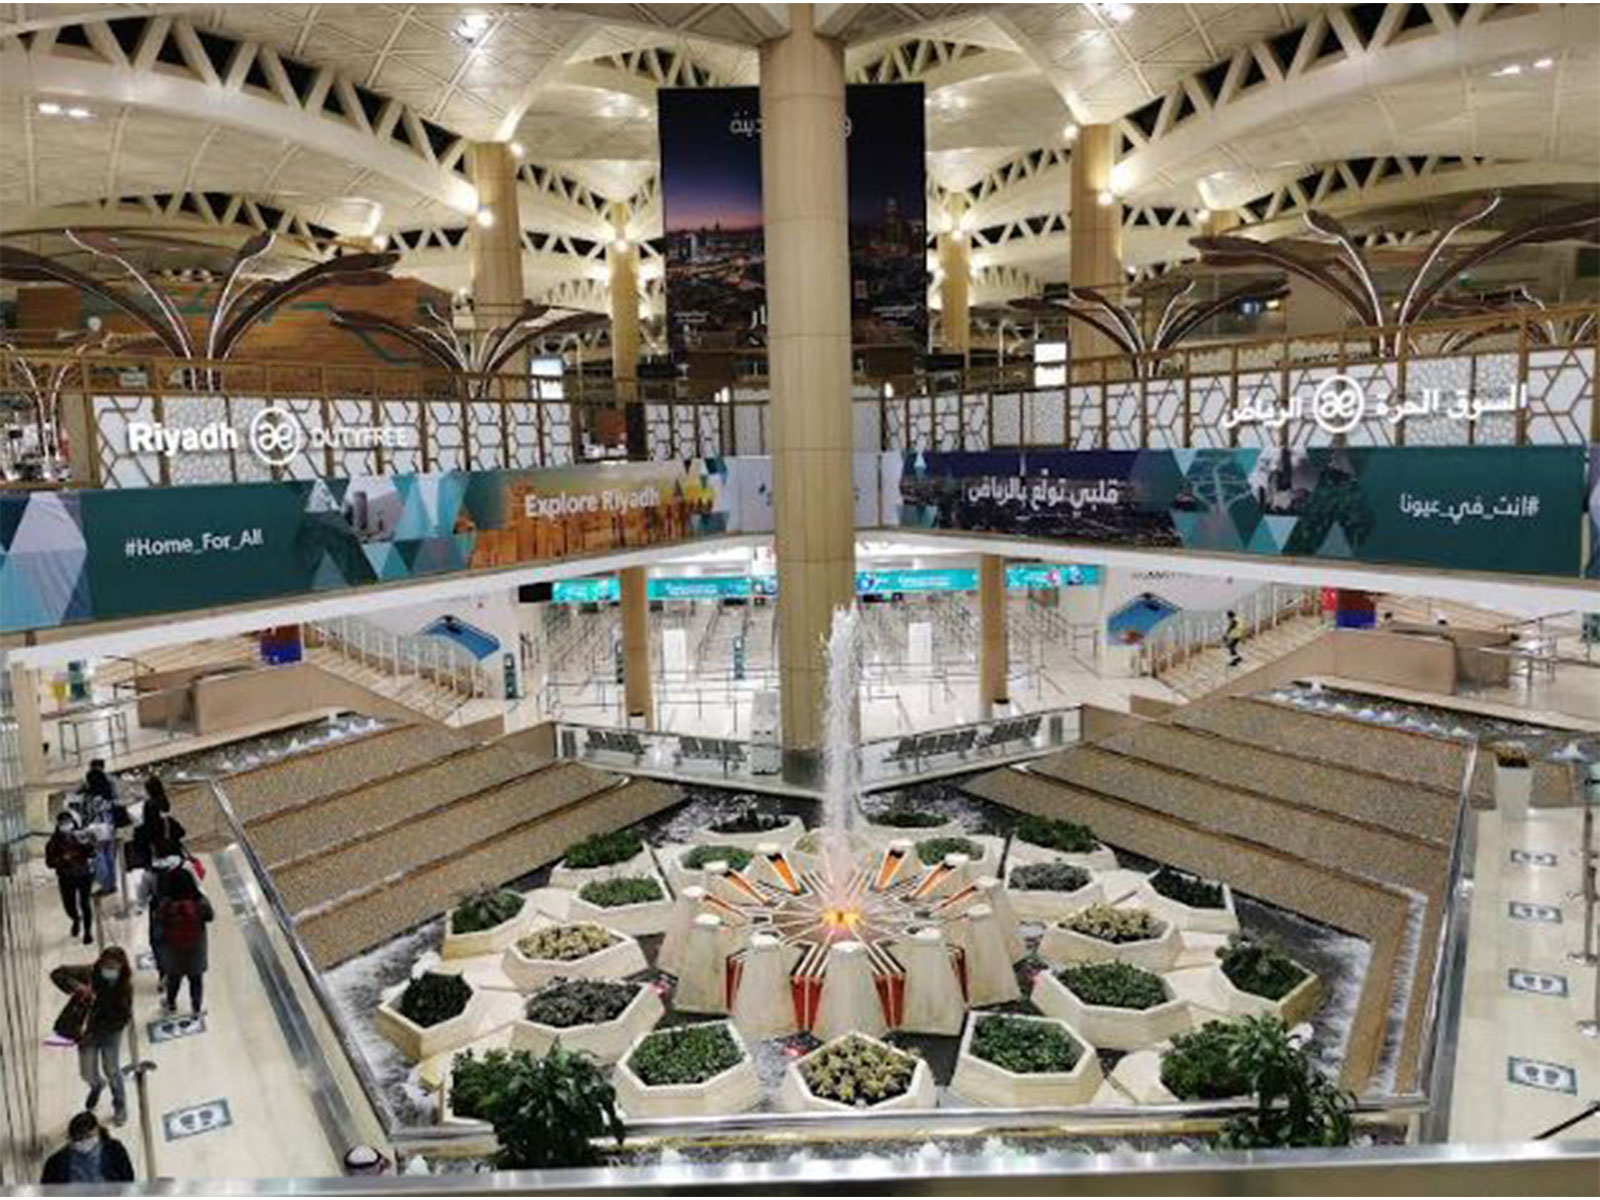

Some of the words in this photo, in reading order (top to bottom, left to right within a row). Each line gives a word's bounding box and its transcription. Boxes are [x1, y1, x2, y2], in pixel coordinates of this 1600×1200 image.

[1220, 395, 1302, 427] الرياض
[1375, 388, 1440, 422] الحرة
[1447, 382, 1528, 419] السوق
[128, 422, 238, 456] Riyadh
[525, 491, 598, 519] Explore
[601, 486, 661, 514] Riyadh
[1070, 477, 1119, 518] قلبي
[124, 528, 264, 557] #Home_For_All
